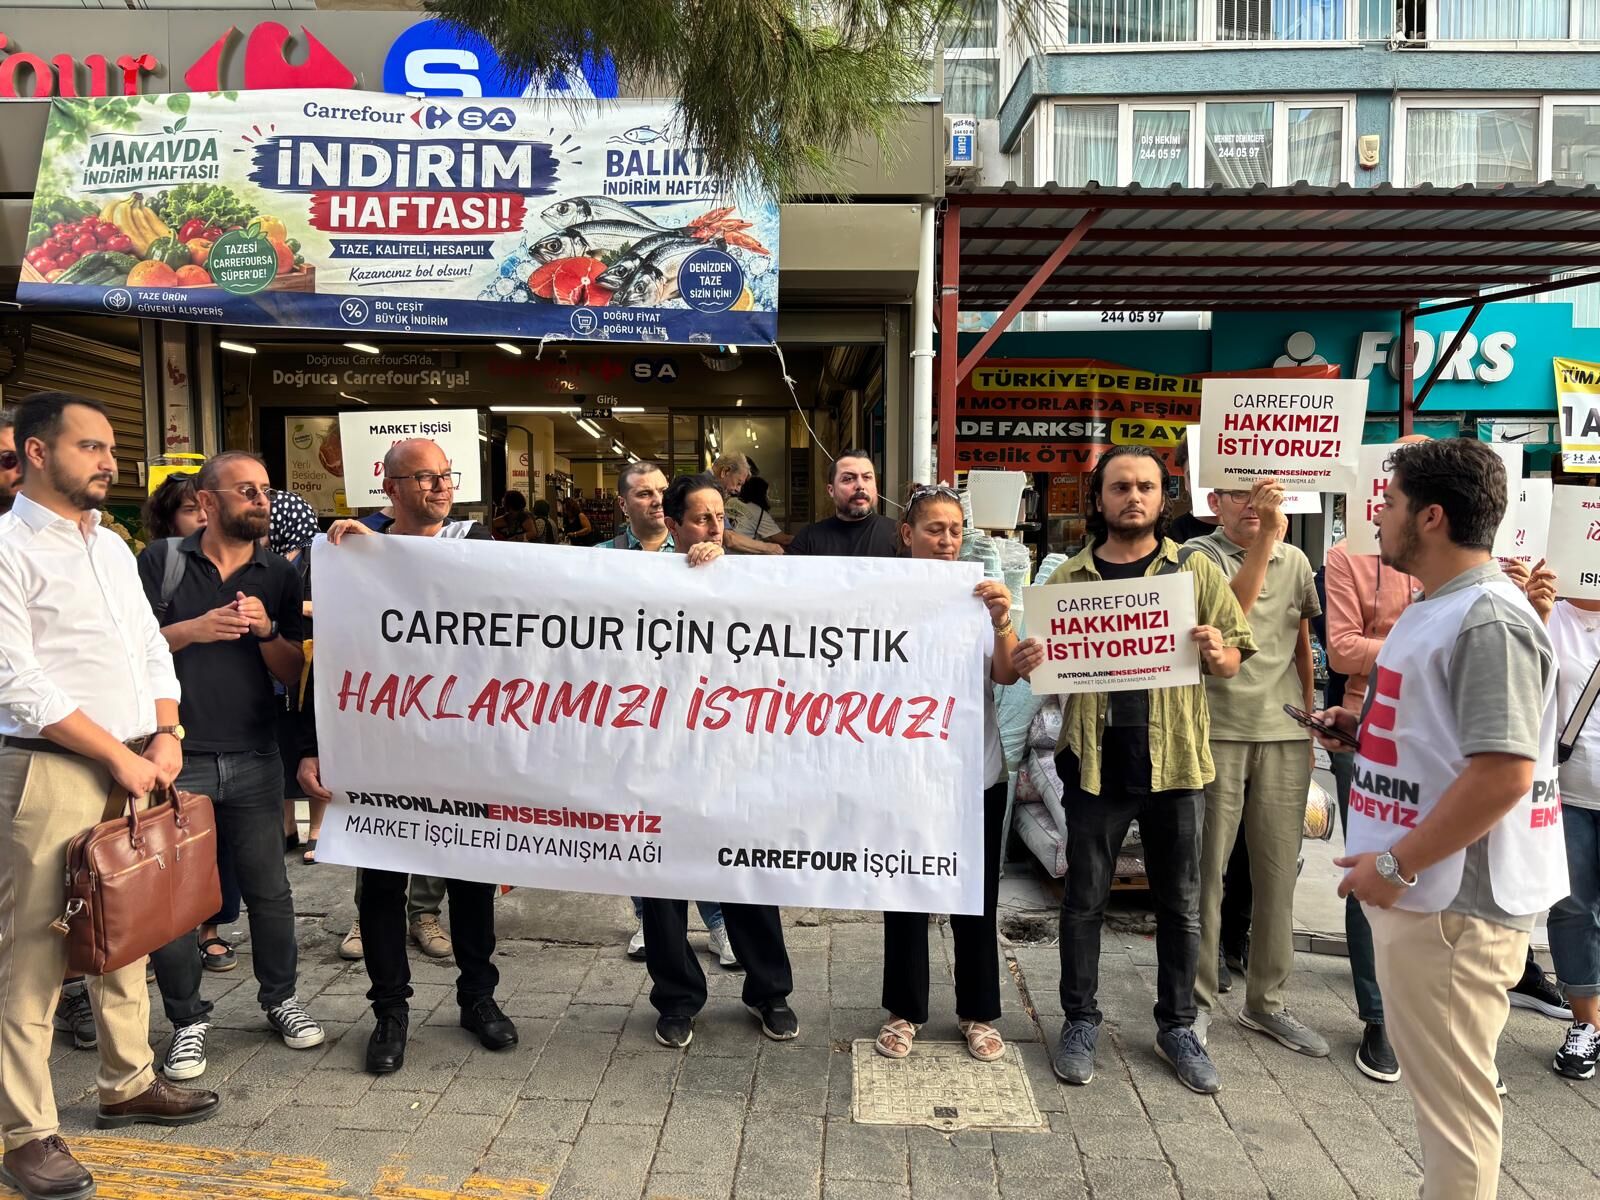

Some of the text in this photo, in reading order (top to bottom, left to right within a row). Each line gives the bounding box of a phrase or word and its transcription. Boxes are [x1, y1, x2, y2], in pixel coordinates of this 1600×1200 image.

[0, 32, 157, 97] our
[303, 102, 512, 127] Carrefour SA
[1155, 135, 1180, 145] HEKİMİ
[87, 138, 219, 167] MANAVDA
[1140, 149, 1181, 159] 244 05 97
[1218, 148, 1259, 158] 244 05 97
[277, 139, 532, 188] İNDİRİM
[606, 149, 723, 177] BALIKT
[83, 165, 219, 185] İNDİRİM HAFTASI!
[603, 180, 660, 195] İNDİRİM
[330, 196, 511, 229] HAFTASI!
[225, 241, 257, 255] TAZESİ
[340, 243, 484, 256] TAZE, KALİTELİ, HESAPLI!
[213, 256, 273, 269] CARREFOURSA
[689, 261, 732, 273] DENİZDEN
[221, 269, 267, 281] SÜPER'DE!
[349, 264, 473, 281] Kazancınız bol olsun!
[699, 276, 722, 286] TAZE
[138, 291, 187, 302] TAZE ÜRÜN
[690, 288, 732, 299] SİZİN İÇİN!
[138, 303, 224, 317] GÜVENLİ ALIŞVERİŞ
[375, 301, 424, 312] BOL ÇEŞİT
[375, 313, 448, 326] BÜYÜK İNDİRİM
[603, 311, 661, 323] DOĞRU FİYAT
[1101, 312, 1164, 323] 244 05 97
[603, 324, 667, 336] DOĞRU KALİTE
[306, 354, 350, 367] Doğrusu
[1353, 330, 1518, 384] FORS
[634, 363, 676, 378] SA
[1562, 367, 1594, 385] TÜM
[273, 370, 470, 389] Doğruca CarrefourSA'ya!
[979, 369, 1129, 389] TÜRKİYE'DE
[1135, 373, 1178, 392] BİR
[597, 394, 619, 405] Giriş
[1233, 394, 1334, 409] CARREFOUR
[971, 397, 1125, 413] MOTORLARDA
[1130, 401, 1193, 418] PEŞİN
[370, 421, 452, 435] MARKET İŞÇİSİ
[999, 421, 1106, 438] FARKSIZ
[1119, 424, 1145, 439] 12
[1224, 413, 1339, 433] HAKKIMIZI
[1217, 433, 1341, 458] İSTİYORUZ!
[957, 447, 1031, 464] stelik
[1036, 446, 1090, 464] ÖTV
[292, 460, 311, 468] Yerli
[292, 470, 327, 479] Besiden
[292, 482, 322, 492] Doğru
[1057, 592, 1160, 612] CARREFOUR
[1051, 610, 1169, 635] HAKKIMIZI
[381, 608, 909, 667] CARREFOUR İÇİN ÇALIŞTIK
[1047, 634, 1176, 661] İSTİYORUZ!
[1057, 665, 1171, 679] PATRONLARINENSESİNDEYİZ
[337, 670, 956, 743] HAKLARIMIZI İSTİYORUZ!
[345, 791, 662, 834] PATRONLARINENSESİNDEYİZ
[345, 815, 661, 863] MARKET İŞÇİLERİ DAYANIŞMA AĞI
[718, 847, 958, 878] CARREFOUR İŞÇİLERİ
